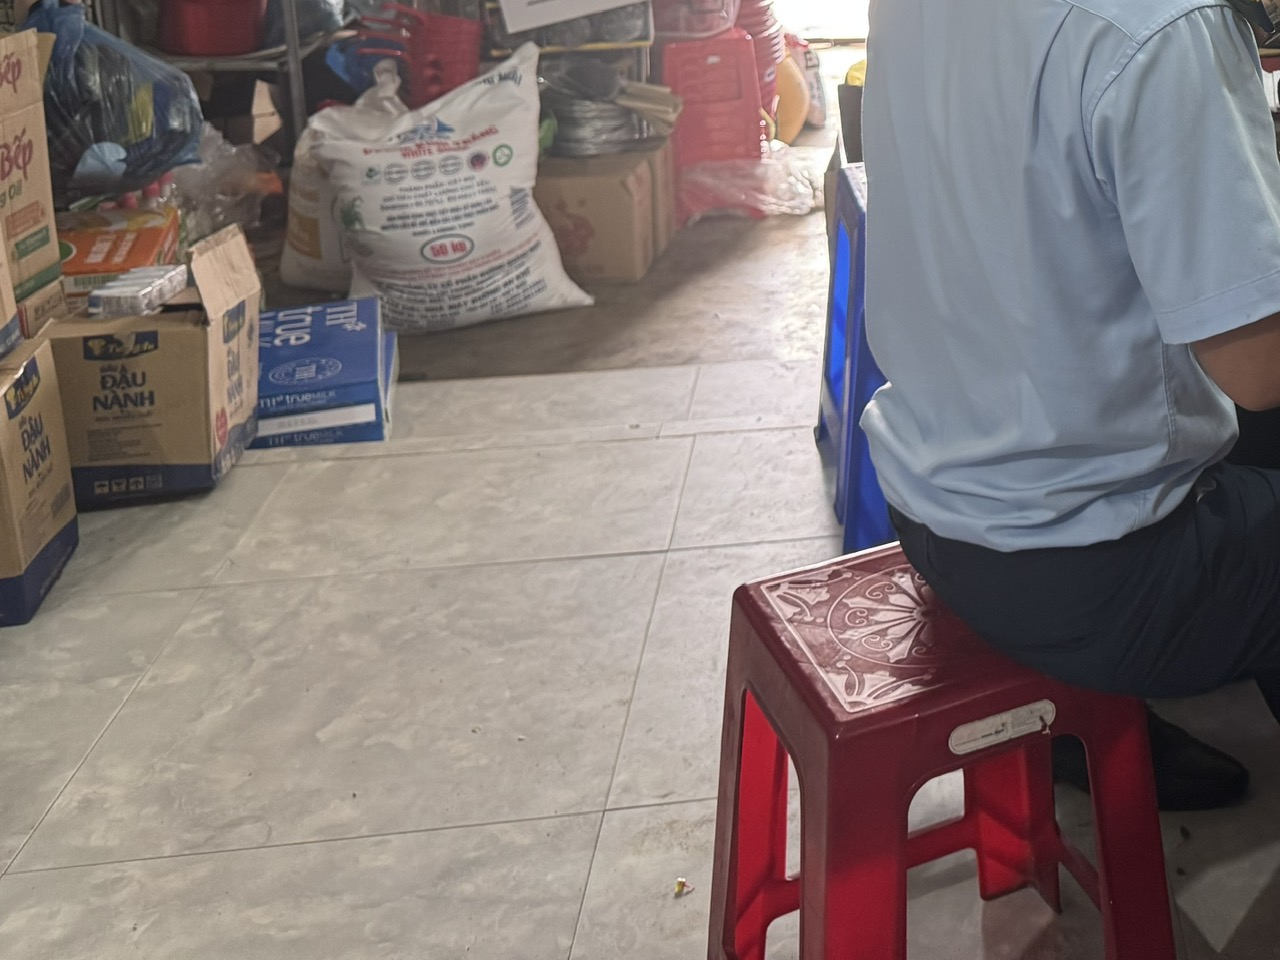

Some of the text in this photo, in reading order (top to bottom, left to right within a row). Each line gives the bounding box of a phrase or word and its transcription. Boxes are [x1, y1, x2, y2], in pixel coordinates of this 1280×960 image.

[430, 243, 449, 258] 50
[273, 305, 323, 347] true
[93, 390, 155, 412] NÀNH
